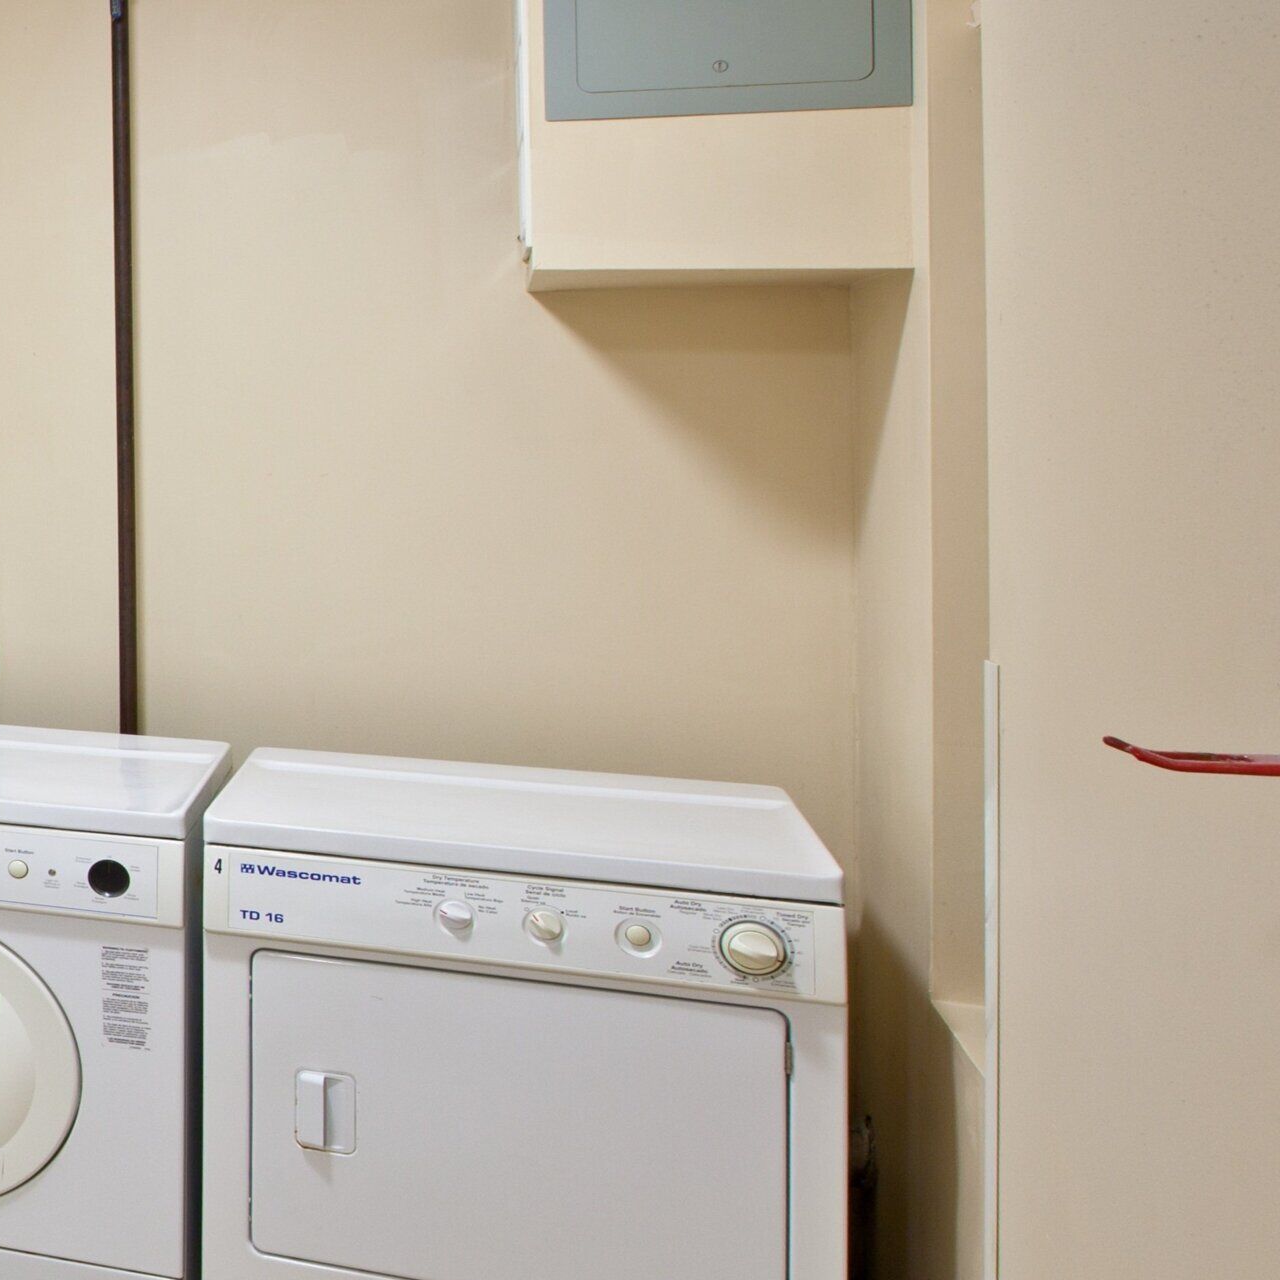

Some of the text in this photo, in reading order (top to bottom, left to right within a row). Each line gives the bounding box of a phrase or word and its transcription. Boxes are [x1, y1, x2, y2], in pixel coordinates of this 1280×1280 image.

[214, 858, 222, 874] 4
[257, 865, 362, 885] Wascomat
[240, 910, 284, 923] TD 16
